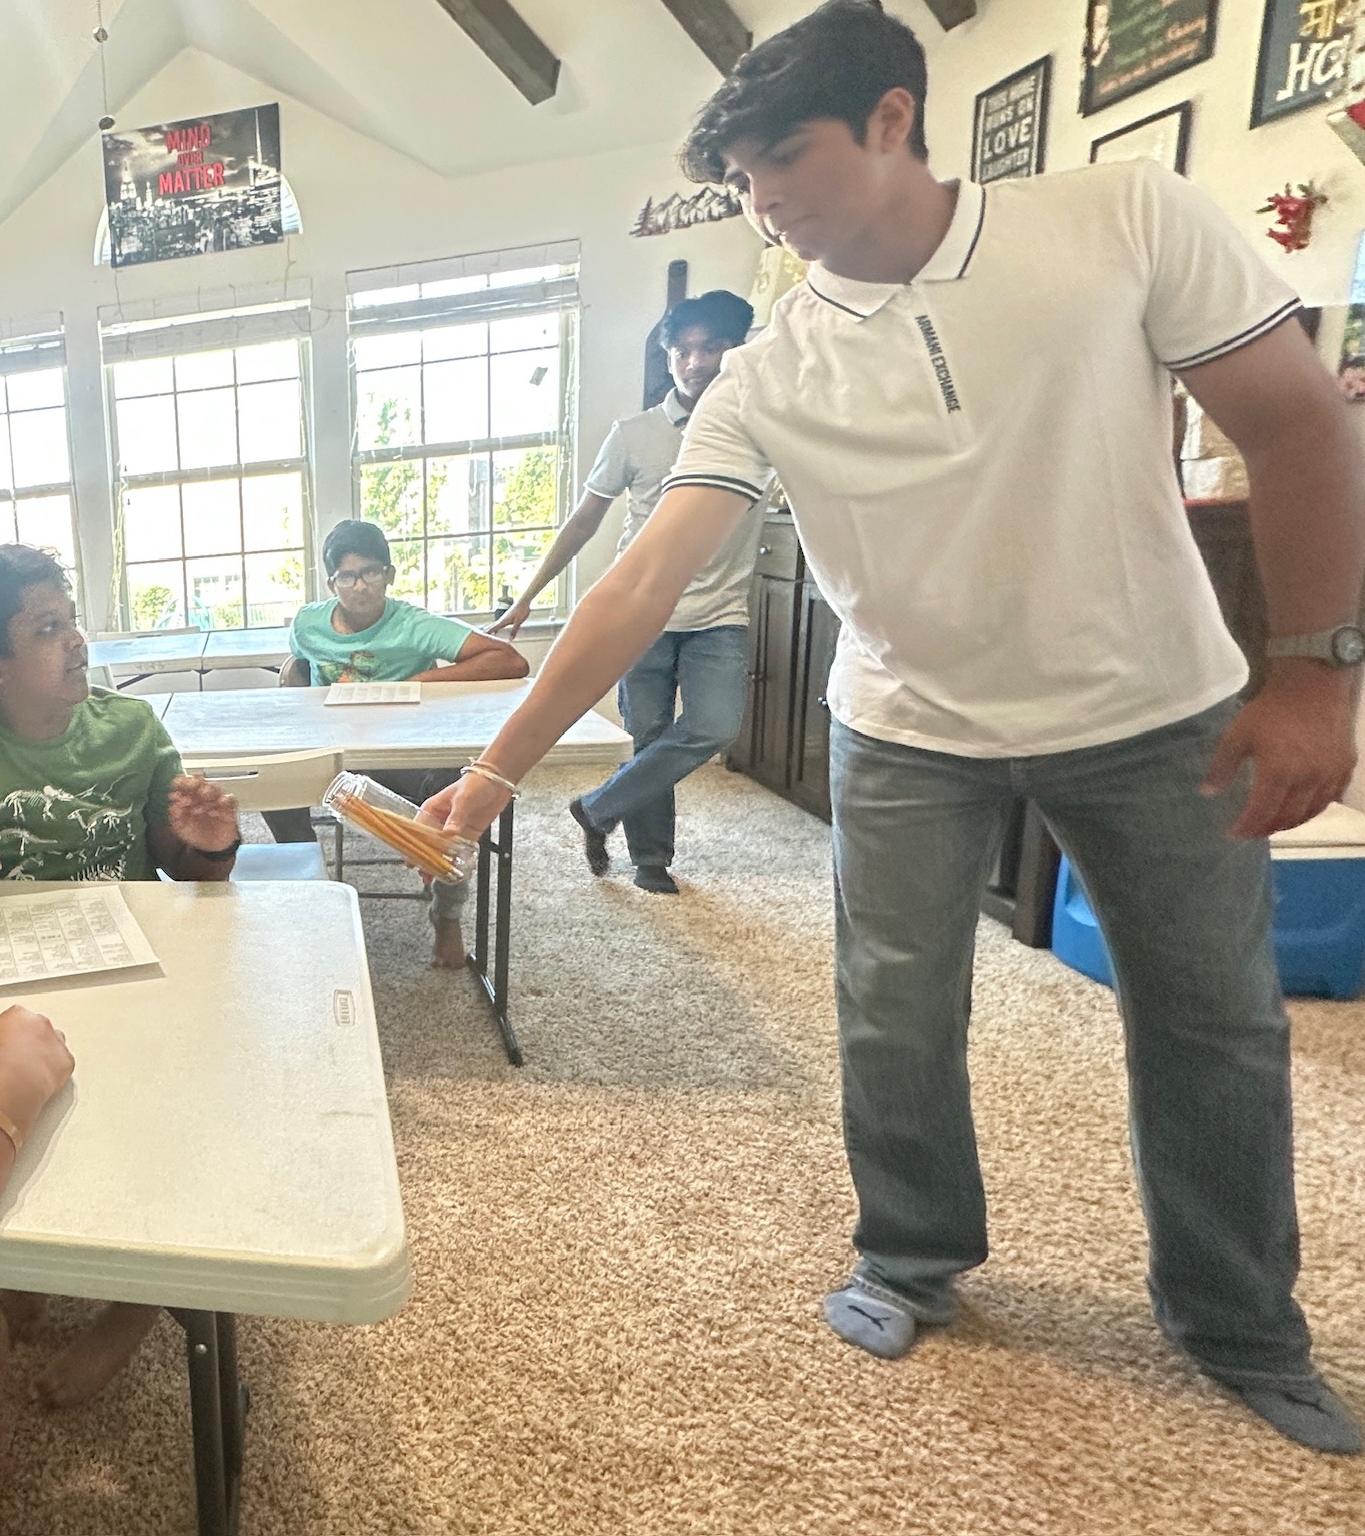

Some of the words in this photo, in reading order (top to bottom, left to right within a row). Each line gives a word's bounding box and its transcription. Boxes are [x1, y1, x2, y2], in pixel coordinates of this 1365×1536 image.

[166, 123, 212, 154] MIND
[983, 116, 1032, 160] LOVE
[177, 151, 203, 167] OVER
[158, 162, 225, 195] MATTER
[915, 314, 943, 357] ARMANI
[931, 355, 961, 414] EXCHANGE
